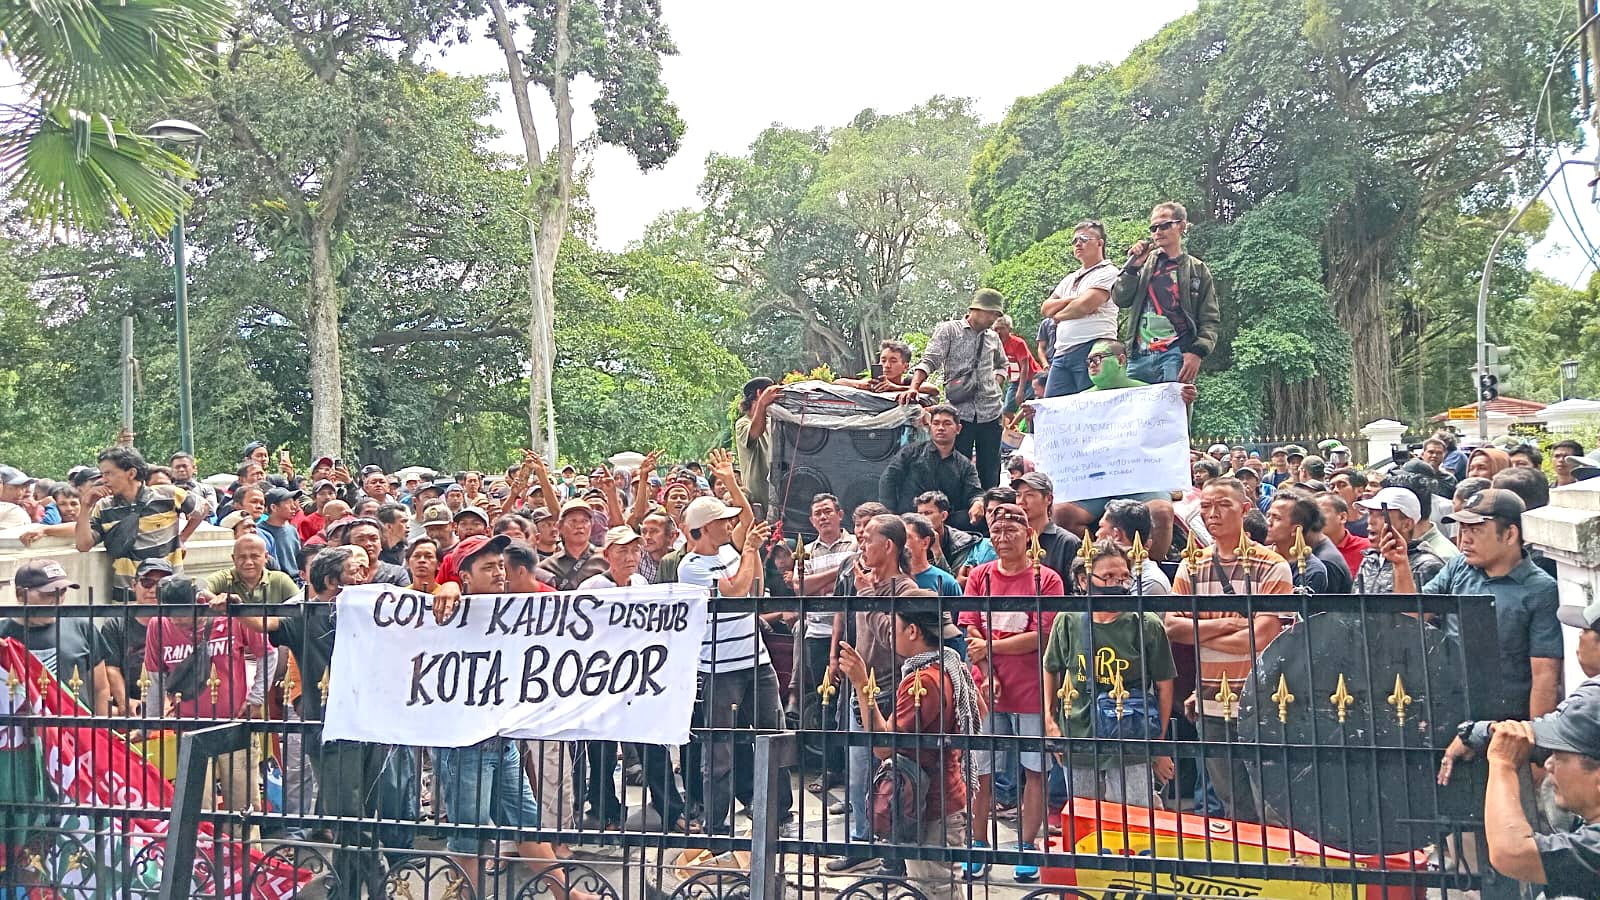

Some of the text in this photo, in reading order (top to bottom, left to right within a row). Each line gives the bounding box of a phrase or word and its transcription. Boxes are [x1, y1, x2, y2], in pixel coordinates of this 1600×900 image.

[485, 595, 603, 641] KADIS
[609, 601, 689, 632] DISHUB
[406, 645, 668, 707] KOTA BOGOR
